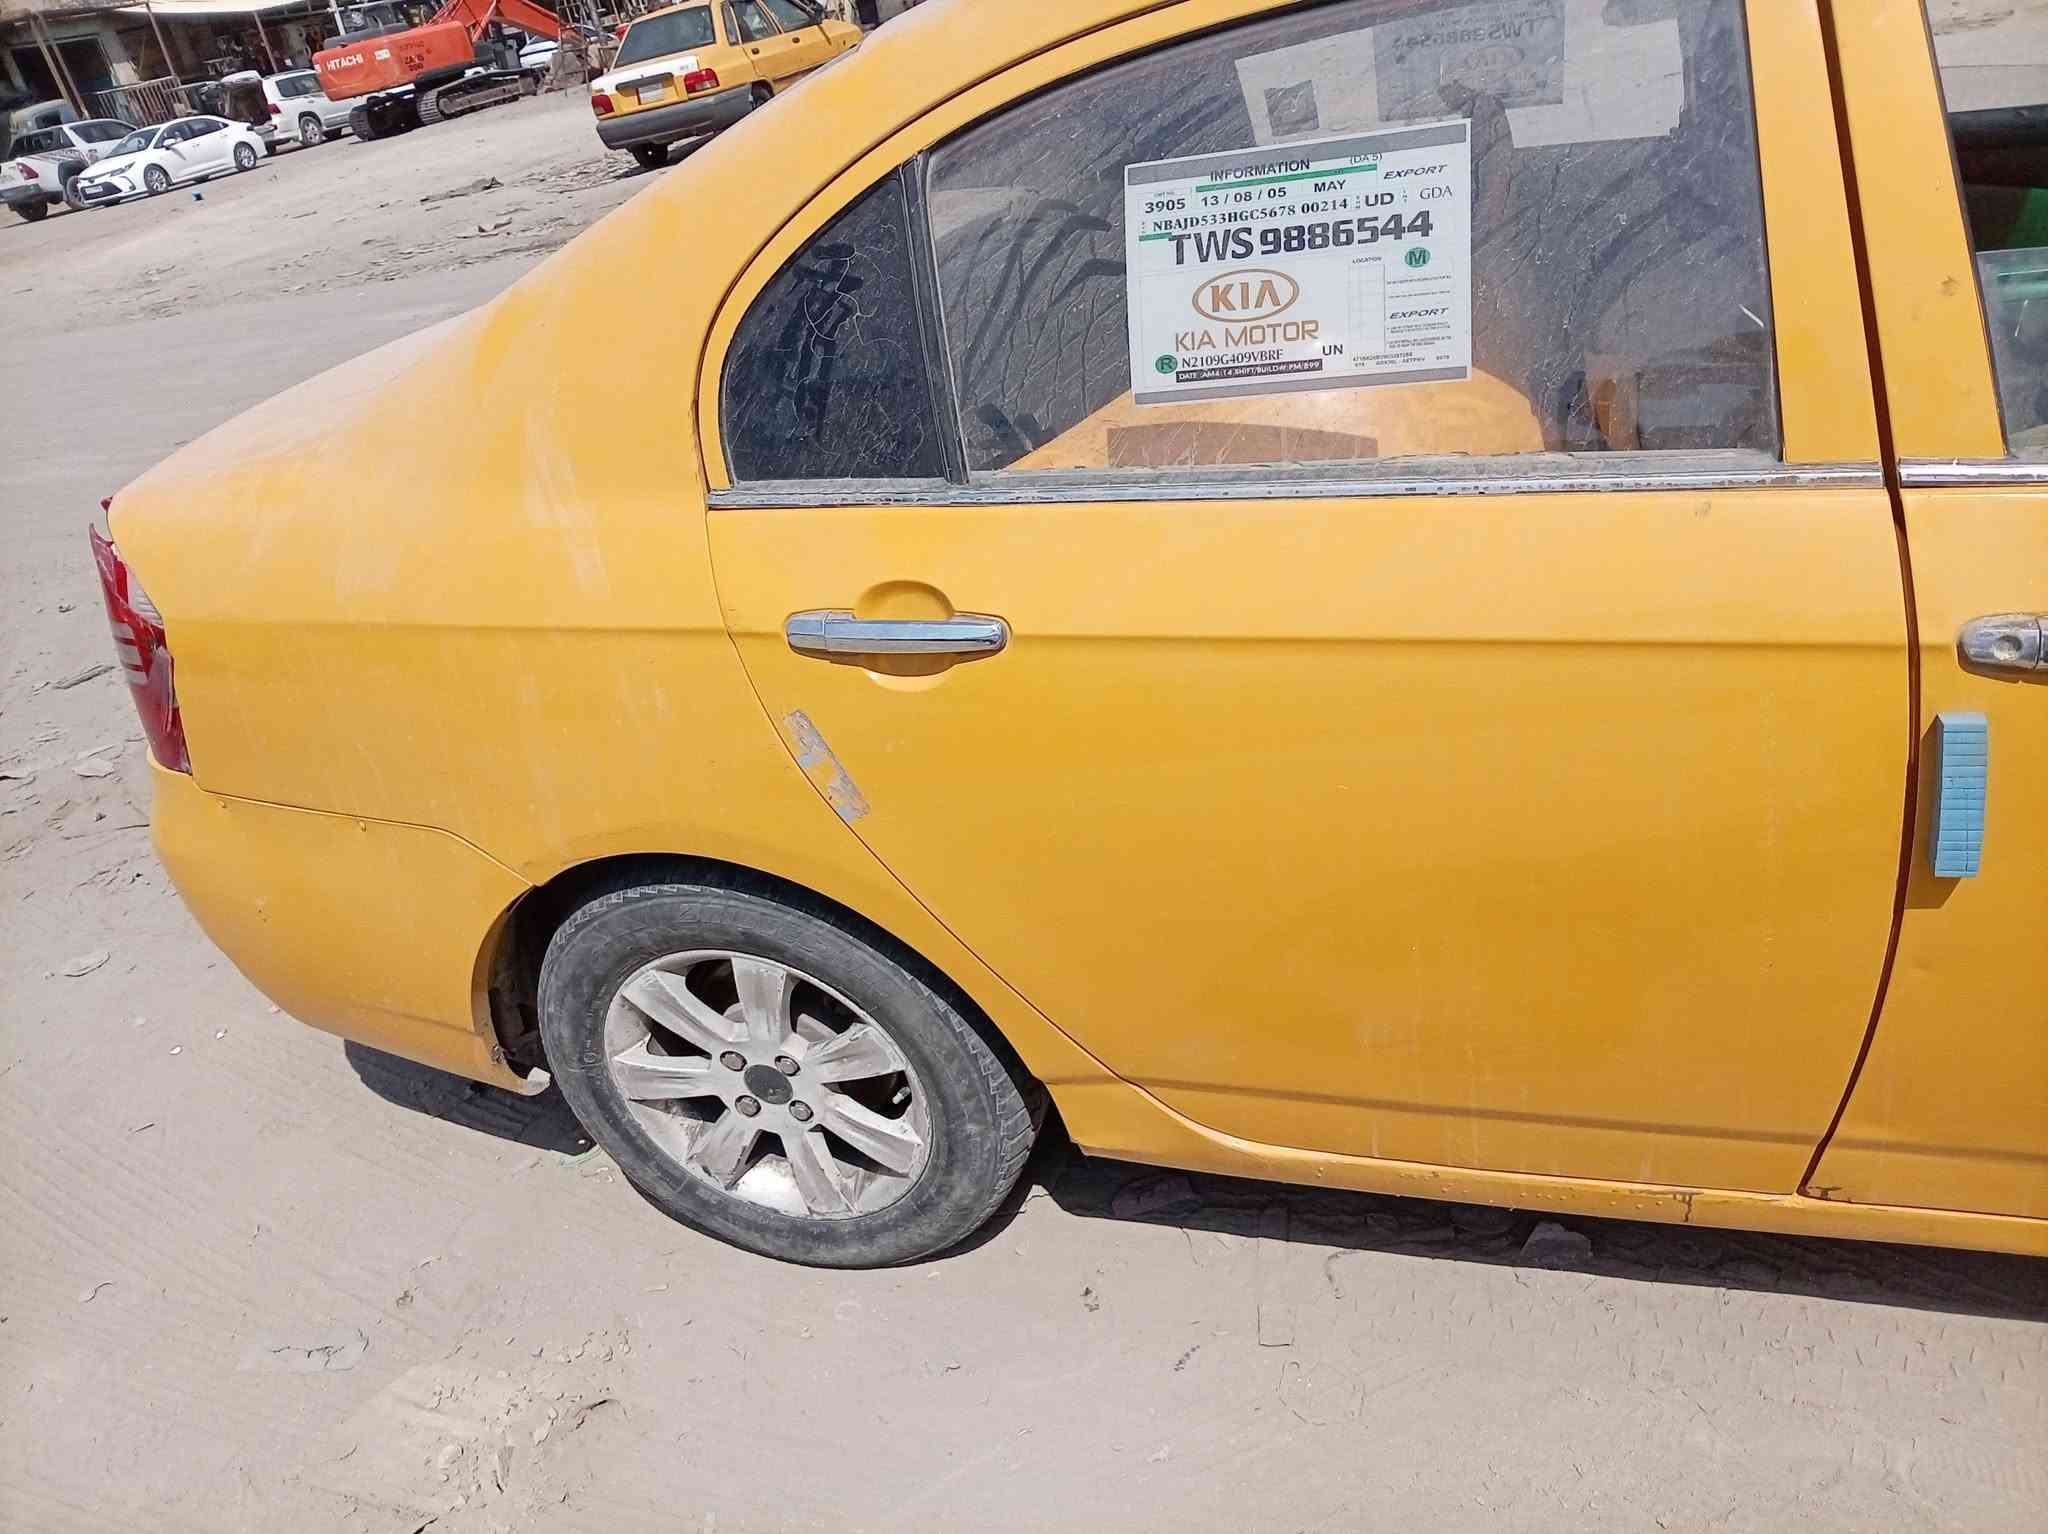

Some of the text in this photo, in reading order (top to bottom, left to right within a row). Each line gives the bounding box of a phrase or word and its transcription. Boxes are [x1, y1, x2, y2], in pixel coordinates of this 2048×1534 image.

[326, 53, 364, 72] HITACHI
[1210, 157, 1312, 182] INFORMATION
[1383, 164, 1448, 180] EXPORT
[1313, 180, 1347, 193] MAY
[1419, 185, 1453, 200] GDA
[1201, 195, 1220, 208] 13
[1233, 191, 1253, 203] 08
[1267, 186, 1287, 198] 05
[1365, 193, 1395, 207] UD
[1144, 198, 1186, 214] 3905
[1300, 198, 1348, 214] 00214
[1408, 250, 1427, 265] M
[1210, 279, 1281, 312] KIA
[1390, 306, 1449, 320] EXPORT
[1175, 319, 1320, 352] KIA MOTOR
[1322, 343, 1344, 356] UN
